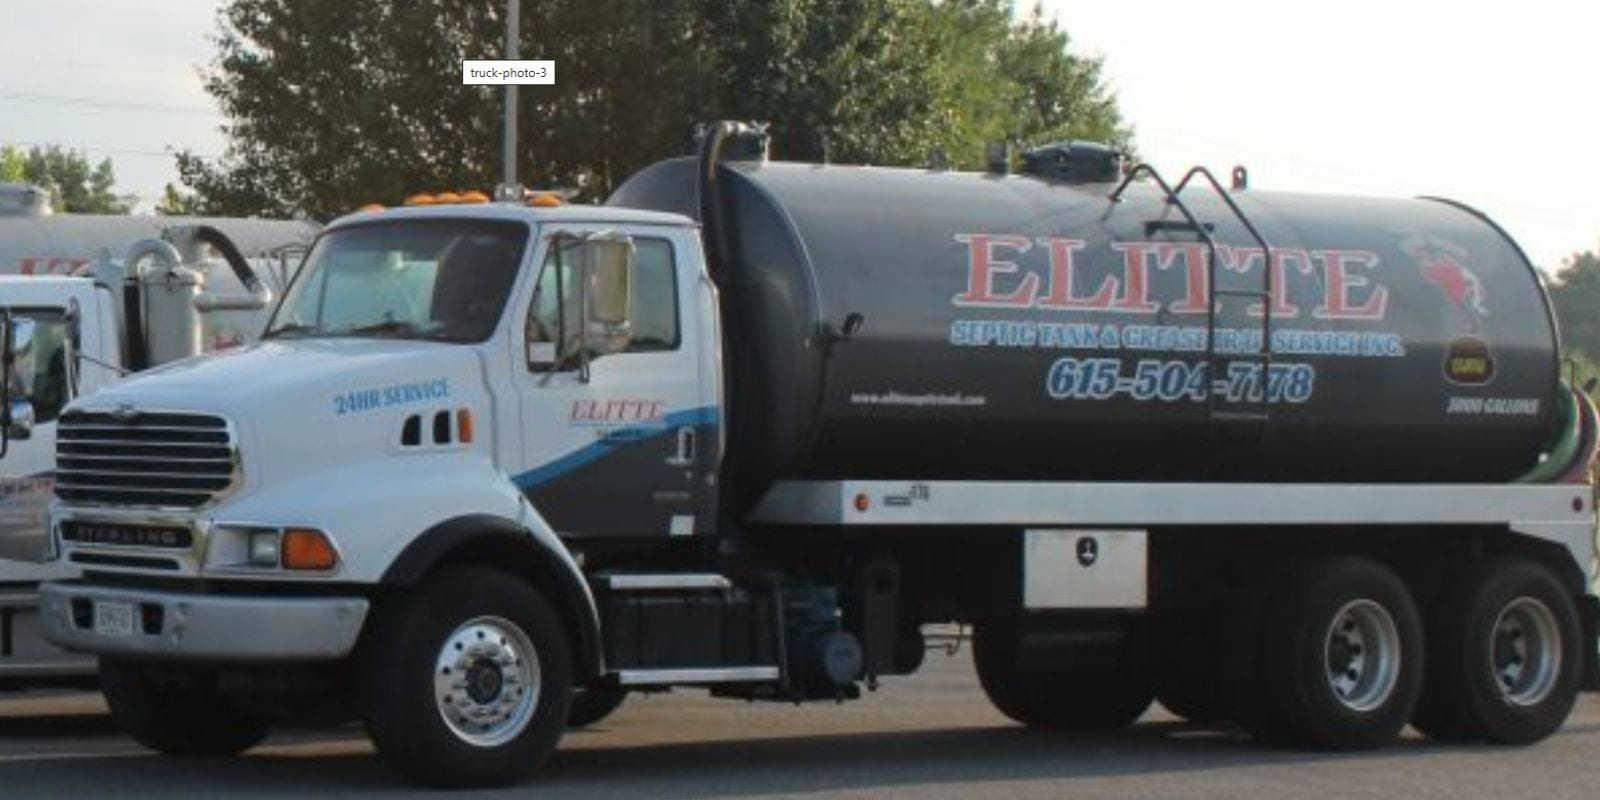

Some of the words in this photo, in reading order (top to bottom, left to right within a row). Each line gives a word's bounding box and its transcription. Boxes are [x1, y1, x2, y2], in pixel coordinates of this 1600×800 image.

[951, 232, 1389, 319] ELITTE
[951, 320, 1036, 346] SEPTIC
[1271, 329, 1360, 356] SERVICE
[334, 388, 381, 415] 24HR
[383, 376, 449, 405] SERVICE
[1048, 358, 1313, 403] 615-504-7178
